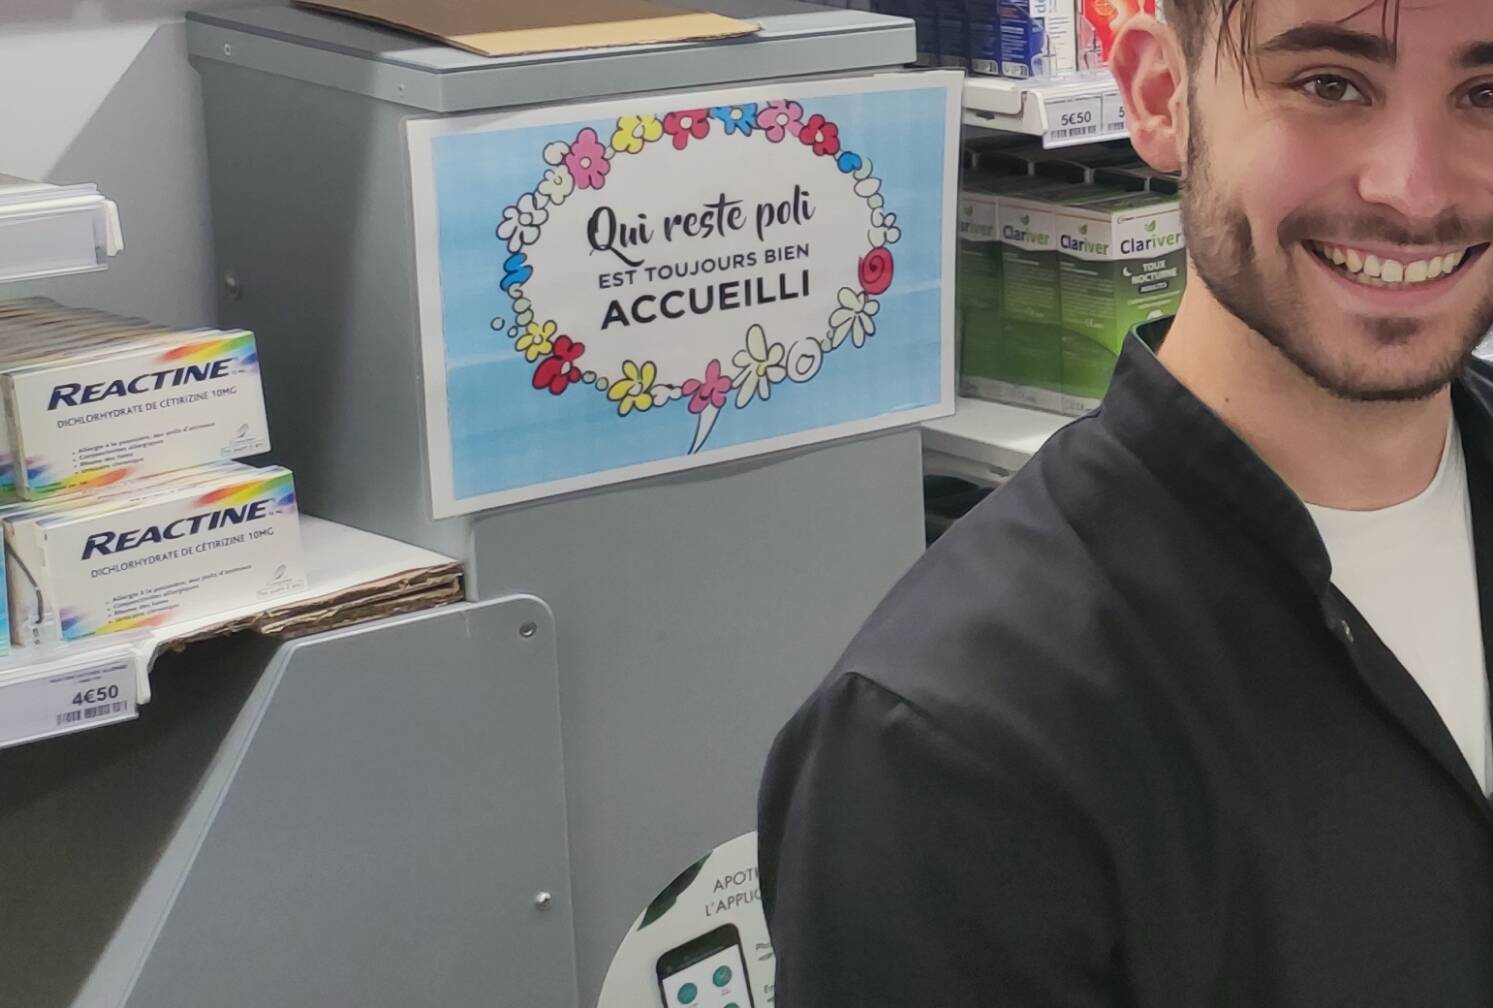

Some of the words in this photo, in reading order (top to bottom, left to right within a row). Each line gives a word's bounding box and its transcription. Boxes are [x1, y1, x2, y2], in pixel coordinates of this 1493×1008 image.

[1061, 111, 1092, 127] 5€50
[586, 204, 655, 268] Qui
[662, 192, 748, 240] reste
[755, 184, 817, 241] poli
[1003, 224, 1050, 246] Clariver
[1060, 233, 1109, 256] Clariver
[1120, 231, 1181, 255] Clariver
[598, 268, 639, 290] EST
[643, 249, 759, 284] TOUJOURS
[764, 242, 811, 265] BIEN
[600, 268, 811, 331] ACCUEILLI
[47, 358, 232, 411] REACTINE
[56, 402, 144, 429] DICHLORHYDRATE
[145, 400, 158, 412] DE
[159, 390, 209, 410] CÉTIRIZINE
[211, 385, 238, 399] 10MG
[80, 499, 268, 561] REACTINE
[90, 550, 180, 579] DICHLORHYDRATE
[180, 544, 194, 558] DE
[195, 533, 246, 555] CÉTIRIZINE
[248, 526, 275, 541] 10MG
[71, 684, 120, 706] 4€50
